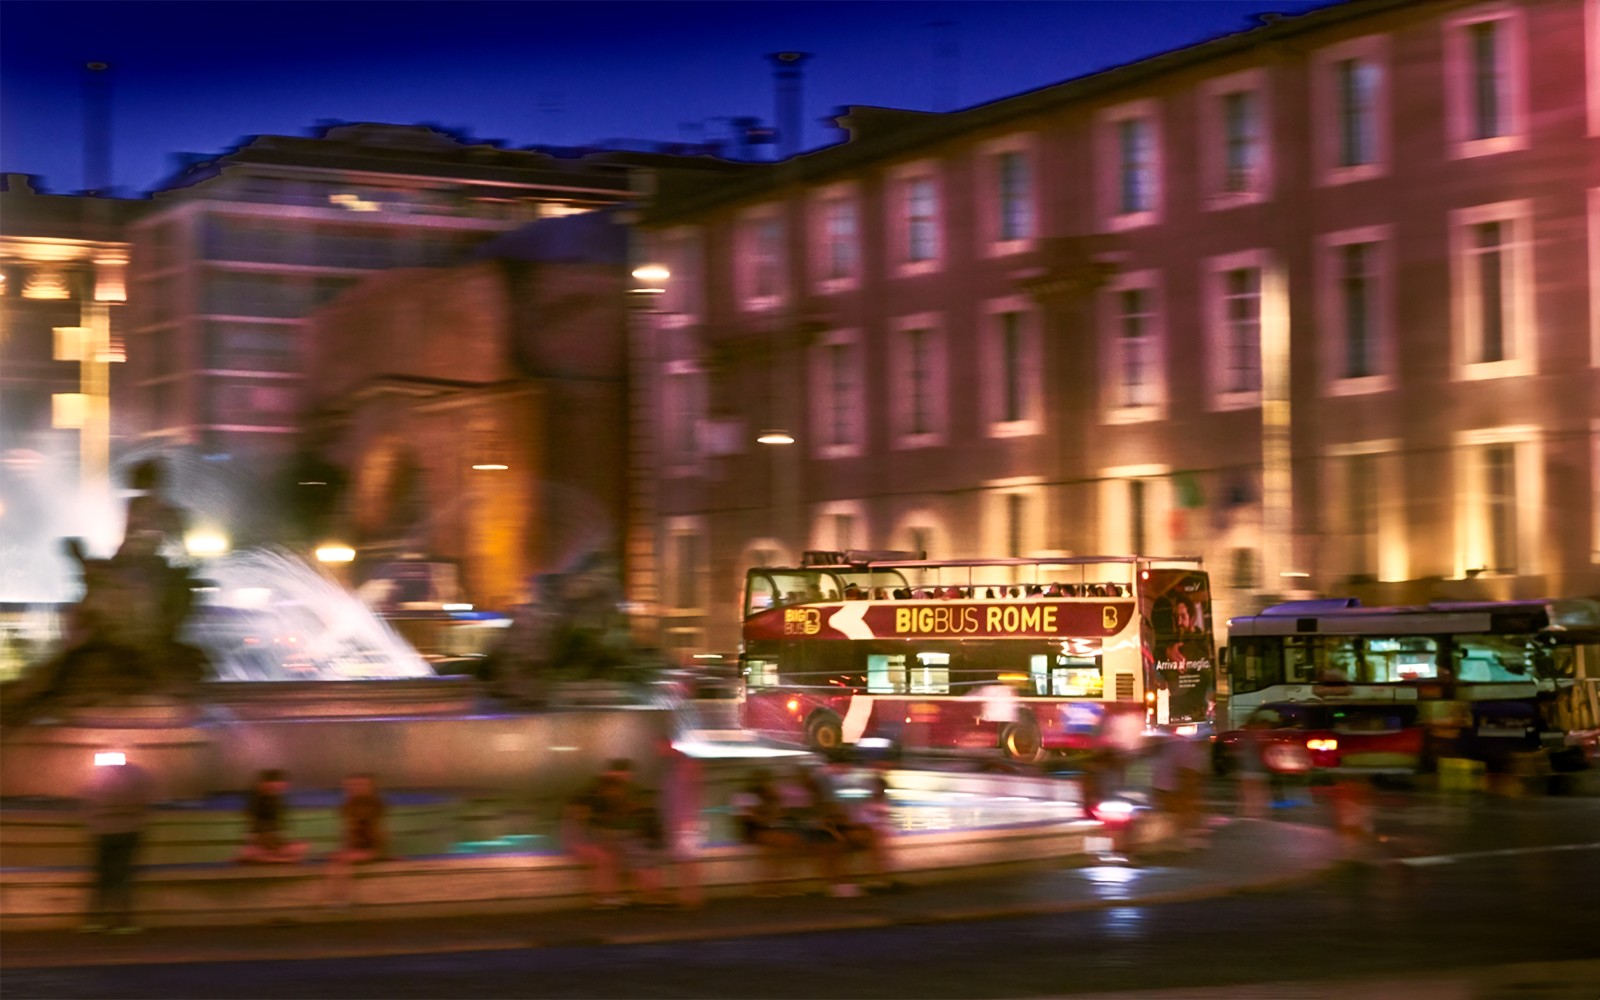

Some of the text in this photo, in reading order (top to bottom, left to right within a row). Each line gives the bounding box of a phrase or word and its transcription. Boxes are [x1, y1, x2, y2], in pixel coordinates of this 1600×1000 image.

[785, 609, 806, 622] BIG
[986, 606, 1058, 632] ROME
[1156, 658, 1178, 670] Arriva
[1179, 657, 1185, 670] al
